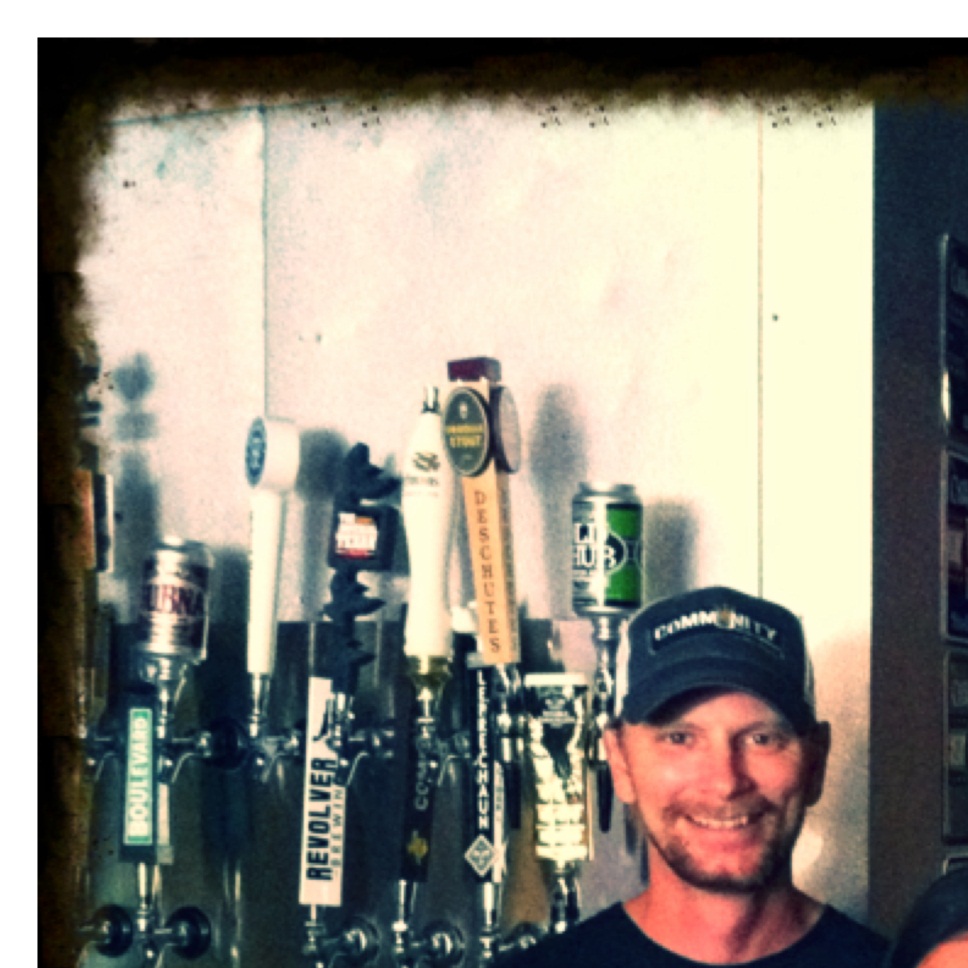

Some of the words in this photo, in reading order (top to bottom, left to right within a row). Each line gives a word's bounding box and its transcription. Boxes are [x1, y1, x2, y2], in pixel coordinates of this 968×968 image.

[474, 490, 500, 653] DESCHUTES
[128, 718, 149, 837] BOULEVARD
[306, 757, 337, 881] REVOLVER
[330, 787, 343, 870] BREWIN
